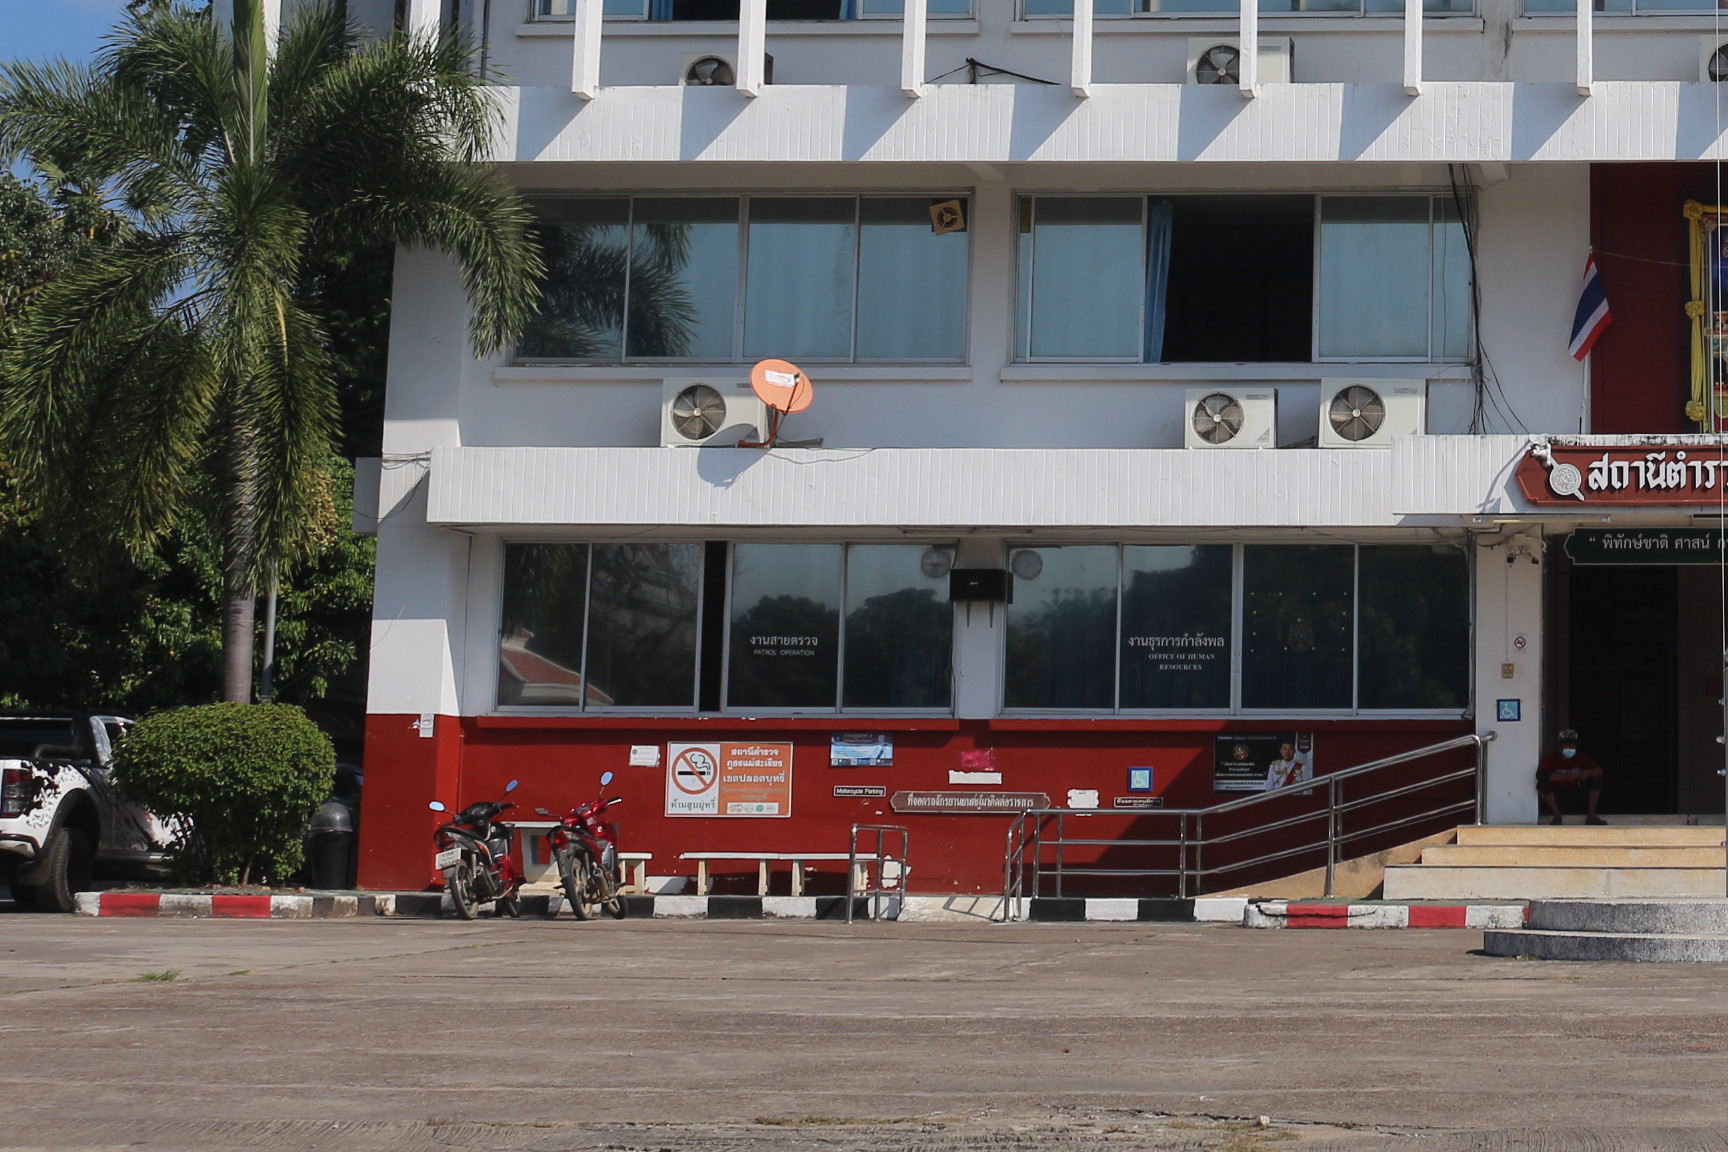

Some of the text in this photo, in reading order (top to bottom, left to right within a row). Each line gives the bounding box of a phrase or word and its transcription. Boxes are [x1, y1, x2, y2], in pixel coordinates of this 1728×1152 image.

[1602, 533, 1669, 549] พิทักษ์ชาติ
[1675, 533, 1711, 549] ศาสน์
[750, 635, 818, 646] งานสายตรวจ
[1128, 632, 1225, 651] งานธุรการกำลังพล
[731, 746, 779, 756] สถานีตำรวจ
[723, 770, 785, 786] เขตปลอดบุหรี่
